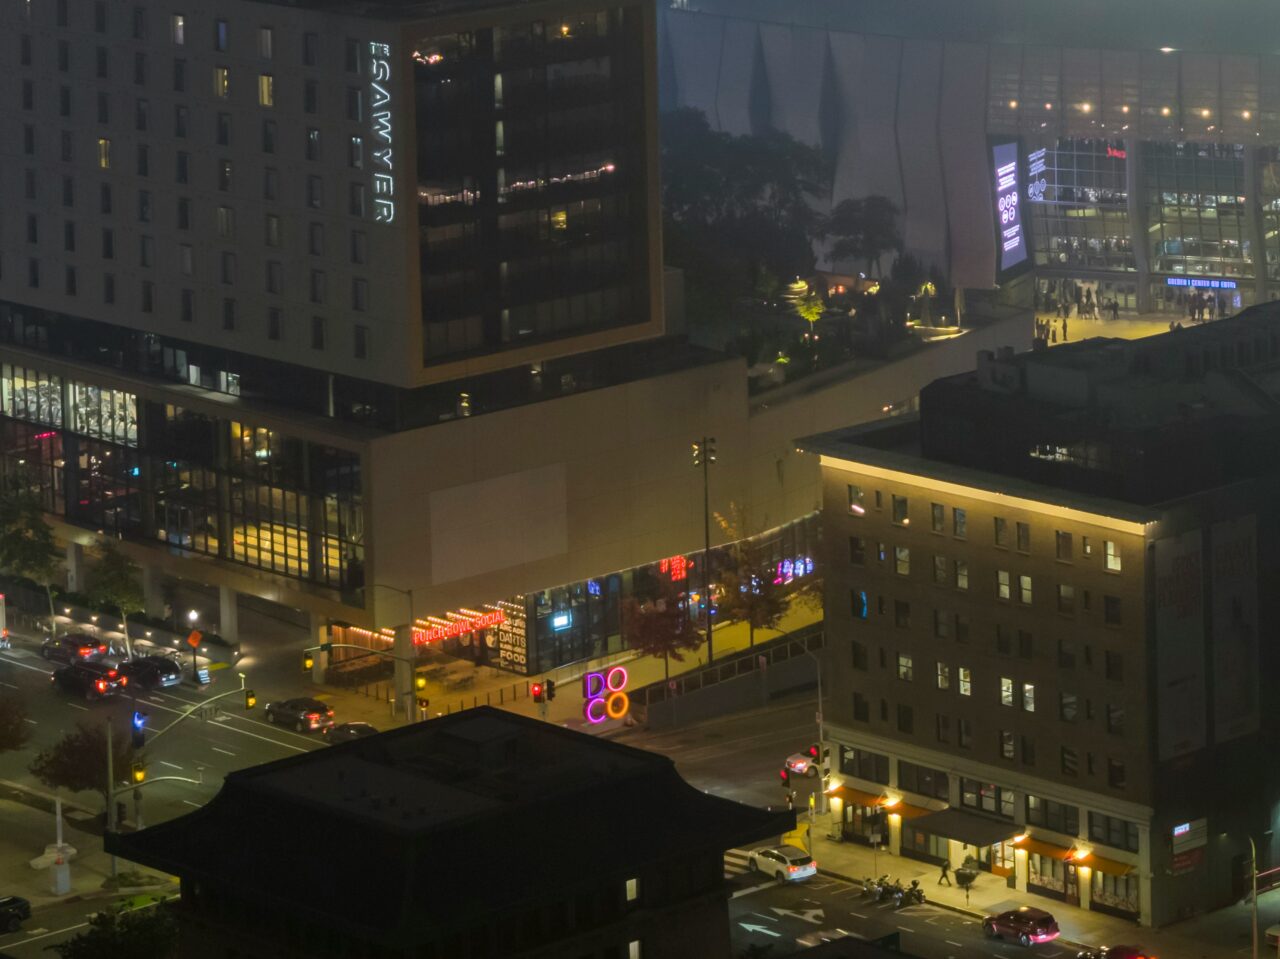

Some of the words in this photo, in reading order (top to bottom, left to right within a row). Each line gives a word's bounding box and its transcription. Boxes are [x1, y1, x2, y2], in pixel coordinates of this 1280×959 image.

[372, 59, 394, 223] SAWYER
[414, 626, 445, 644] PUNCH
[446, 620, 472, 636] BOWL
[474, 609, 505, 629] SOCIAL
[499, 631, 527, 648] DARTS
[500, 650, 526, 665] FOOD
